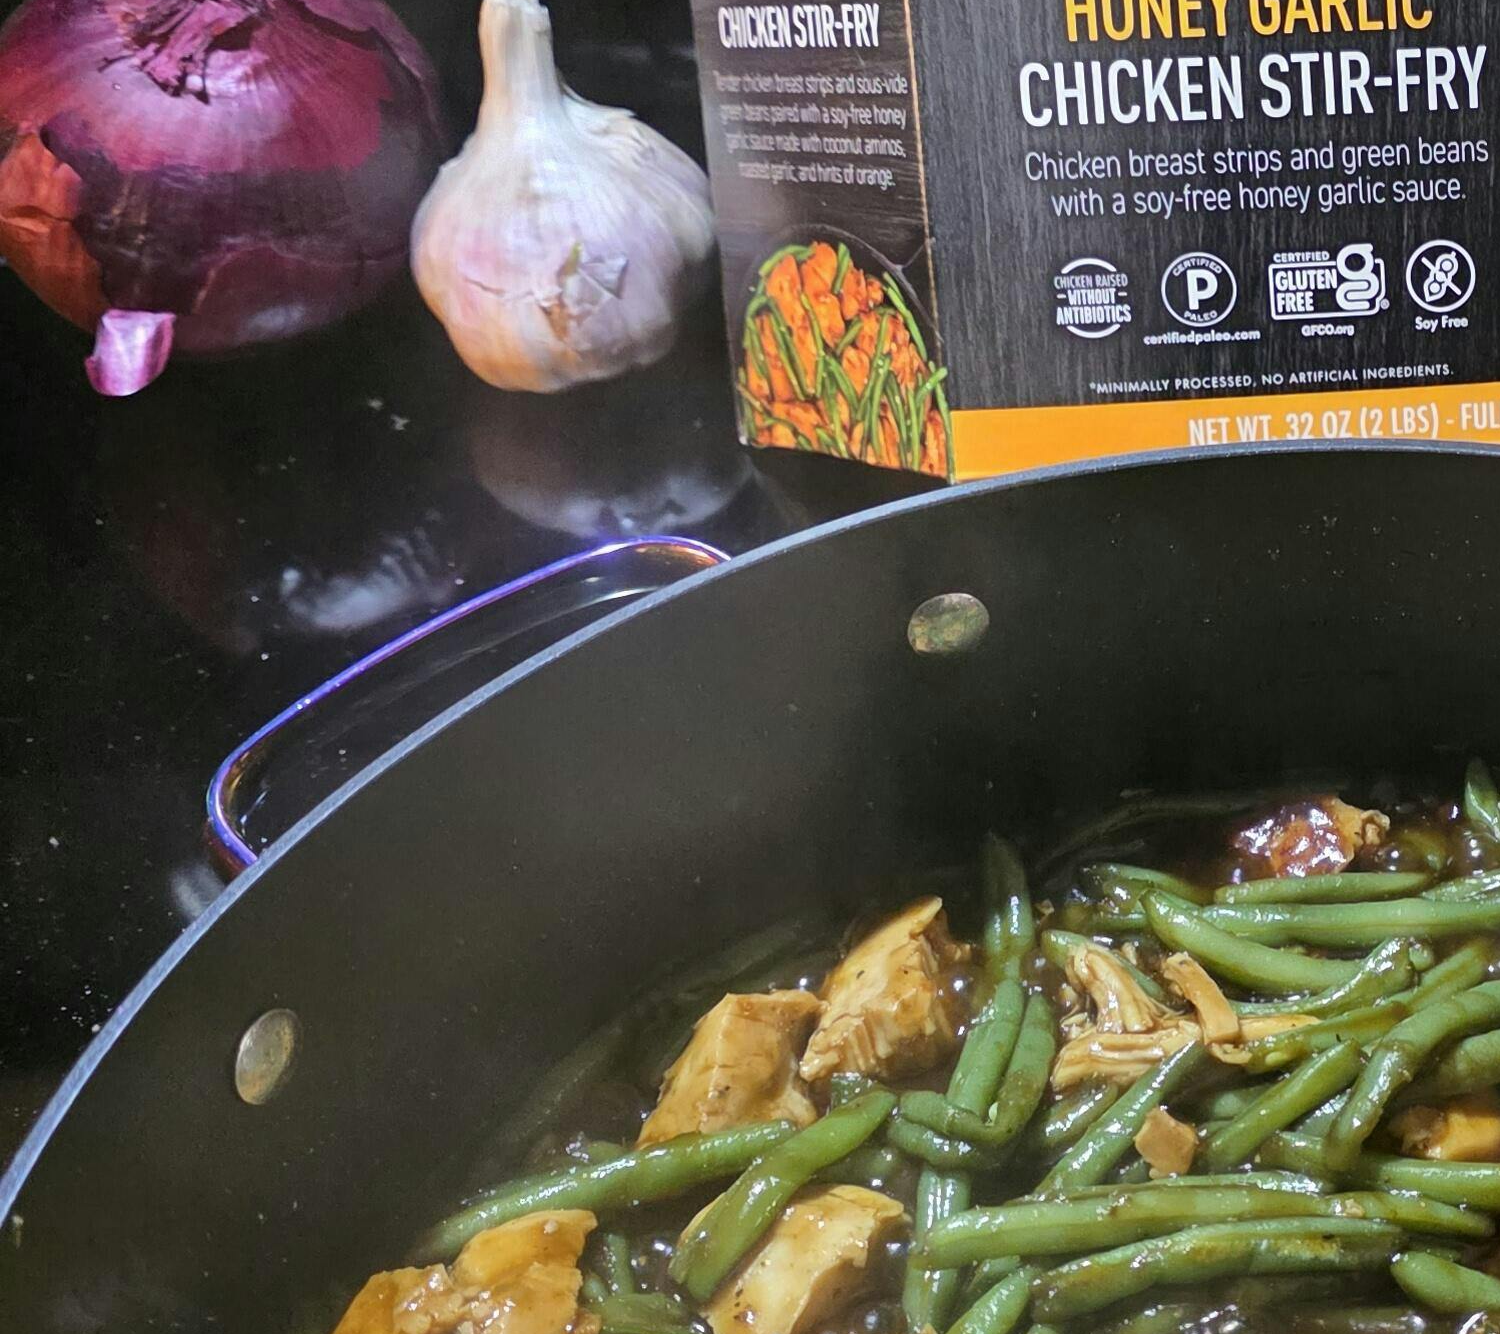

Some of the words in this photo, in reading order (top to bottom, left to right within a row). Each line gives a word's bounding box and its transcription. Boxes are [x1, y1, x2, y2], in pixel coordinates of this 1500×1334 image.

[718, 4, 793, 49] CHICKEN
[792, 3, 880, 48] STIR-FRY
[835, 75, 855, 94] and
[857, 73, 908, 95] sous-vide
[1019, 55, 1244, 127] CHICKEN
[1259, 44, 1487, 117] STIR-FRY
[822, 107, 830, 124] a
[831, 103, 872, 129] soy-free
[873, 104, 906, 130] honey
[1024, 151, 1120, 181] Chicken
[1129, 147, 1205, 177] breast
[1214, 143, 1282, 178] strips
[1290, 141, 1334, 169] and
[1343, 141, 1410, 175] green
[1419, 136, 1488, 164] beans
[1051, 187, 1103, 217] with
[1112, 193, 1126, 214] a
[1134, 183, 1231, 219] soy-free
[1239, 181, 1310, 214] honey
[1320, 177, 1386, 212] garlic
[1393, 175, 1466, 203] sauce.
[1172, 258, 1222, 277] CERTIFIED
[1273, 251, 1330, 263] CERTIFIED
[1054, 275, 1093, 289] CHICKEN
[1096, 274, 1128, 287] RAISED
[1186, 269, 1218, 310] P
[1275, 269, 1338, 291] GLUTEN
[1067, 289, 1116, 305] WITHOUT
[1277, 292, 1314, 313] FREE
[1056, 305, 1132, 325] ANTIBIOTICS
[1184, 310, 1217, 322] PALEO
[1415, 316, 1438, 333] Soy
[1442, 315, 1469, 328] Free
[1143, 329, 1261, 346] certifiedpaleo.com
[1301, 324, 1354, 337] GFCO.org
[1175, 374, 1257, 390] PROCESSED,
[1262, 373, 1284, 385] NO
[1289, 369, 1358, 384] ARTIFICIAL
[1363, 364, 1454, 379] INGREDIENTS.
[1188, 418, 1231, 447] NET
[1285, 411, 1315, 439] 32
[1322, 409, 1352, 439] OZ
[1359, 406, 1384, 438] (2
[1391, 402, 1440, 439] LBS)
